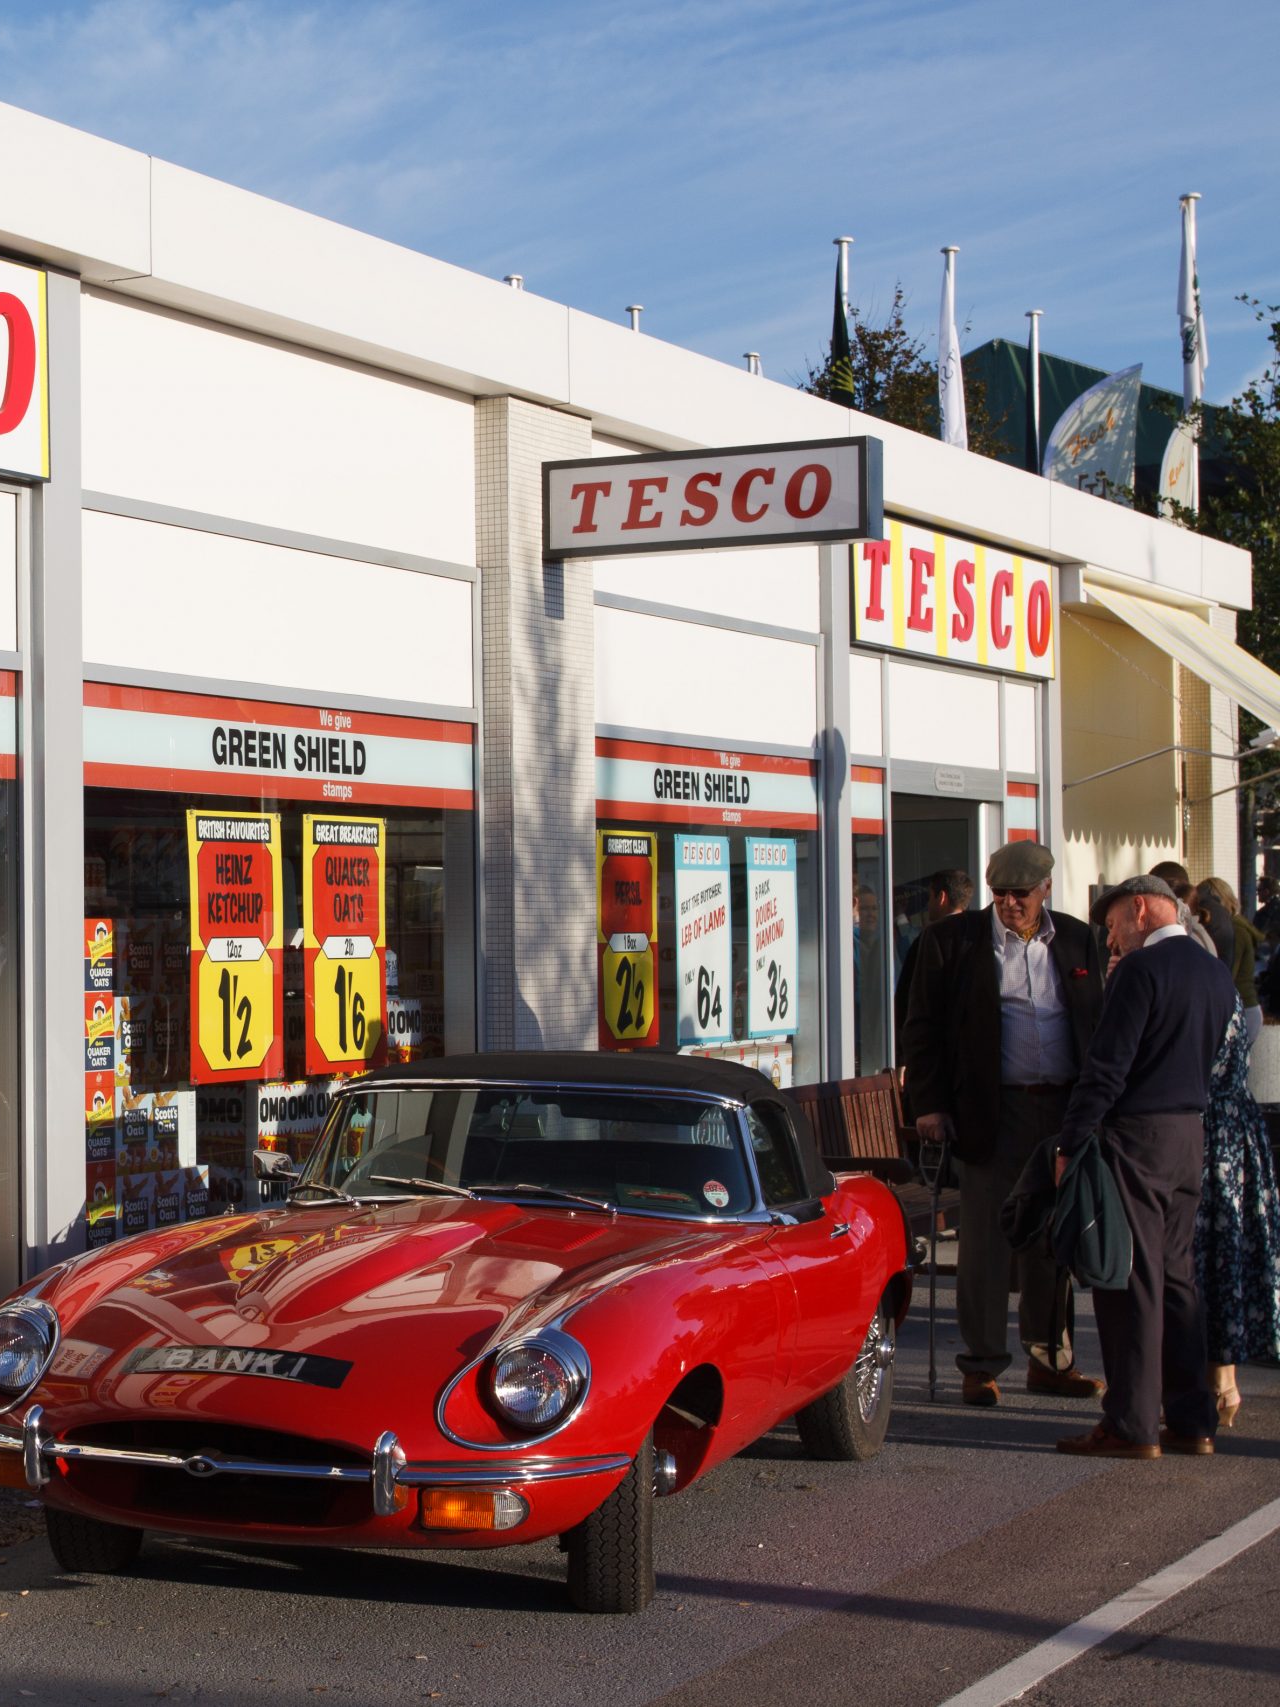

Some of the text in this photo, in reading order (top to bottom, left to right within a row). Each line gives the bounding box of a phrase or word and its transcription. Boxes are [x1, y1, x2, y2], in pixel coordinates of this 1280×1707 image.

[570, 463, 832, 534] TESCO
[863, 539, 1051, 657] TESCO
[320, 710, 352, 730] We give
[212, 727, 367, 775] GREEN SHIELD
[720, 752, 741, 768] We give
[322, 782, 352, 800] stamps
[654, 768, 750, 804] GREEN SHIELD
[722, 809, 742, 824] stamps
[198, 820, 270, 840] BRITISH FAVOURITES
[316, 825, 377, 844] GREAT BREAKFASTS
[684, 846, 720, 861] TESCO
[754, 847, 786, 861] TESCO
[216, 854, 253, 886] HEINZ
[325, 857, 369, 887] QUAKER
[758, 879, 771, 899] PACK
[207, 892, 262, 924] KETCHUP
[333, 894, 363, 923] OATS
[691, 893, 700, 909] THE
[755, 897, 777, 929] DOUBLE
[681, 904, 726, 948] LEG OF LAMB
[755, 918, 785, 952] DIAMOND
[226, 940, 242, 958] 12oz
[90, 968, 113, 979] QUAKER
[684, 968, 696, 986] ONLY
[94, 978, 109, 987] OATS
[396, 1011, 419, 1034] OMO
[87, 1047, 111, 1058] QUAKER
[91, 1057, 107, 1066] OATS
[124, 1110, 147, 1122] Scott's
[155, 1108, 178, 1119] Scott's
[260, 1094, 314, 1122] OMO OMO
[127, 1125, 144, 1136] Oats
[158, 1122, 175, 1133] Oats
[88, 1137, 111, 1148] QUAKER
[92, 1147, 107, 1156] OATS
[157, 1197, 178, 1208] Scott's
[187, 1192, 208, 1203] Scott's
[125, 1201, 148, 1213] Scott's
[160, 1210, 176, 1221] Oats
[189, 1205, 206, 1216] Oats
[127, 1214, 144, 1225] Oats
[160, 1349, 284, 1376] BANK
